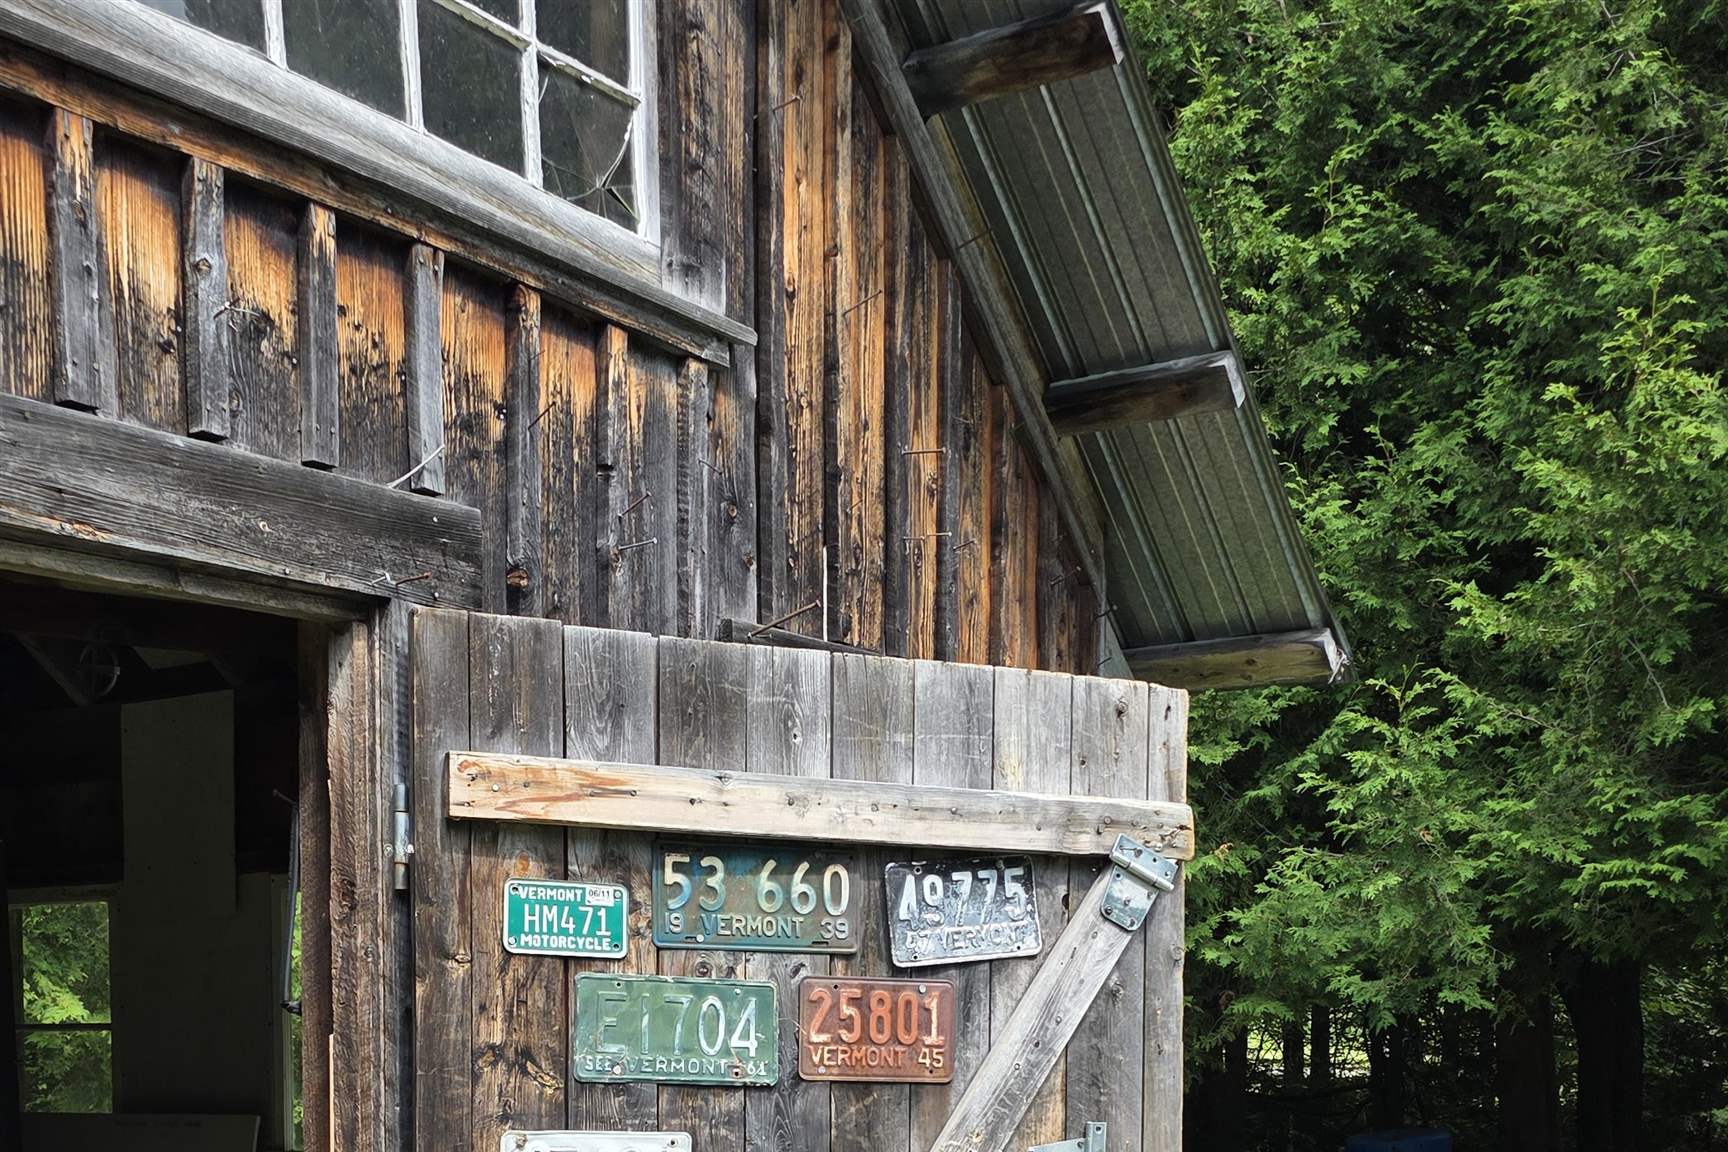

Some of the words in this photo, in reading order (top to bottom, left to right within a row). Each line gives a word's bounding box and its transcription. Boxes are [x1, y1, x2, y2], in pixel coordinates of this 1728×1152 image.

[519, 886, 583, 901] VERMONT
[664, 853, 726, 911] 53
[757, 859, 850, 916] 660
[524, 903, 611, 936] HM471
[665, 912, 684, 934] 19
[700, 913, 804, 939] VERMONT
[820, 918, 849, 940] 39
[520, 933, 612, 951] MOTORCYCLE
[808, 987, 946, 1046] 25801
[627, 1056, 728, 1075] VERMONT
[810, 1045, 907, 1068] VERMONT
[917, 1048, 945, 1068] 45
